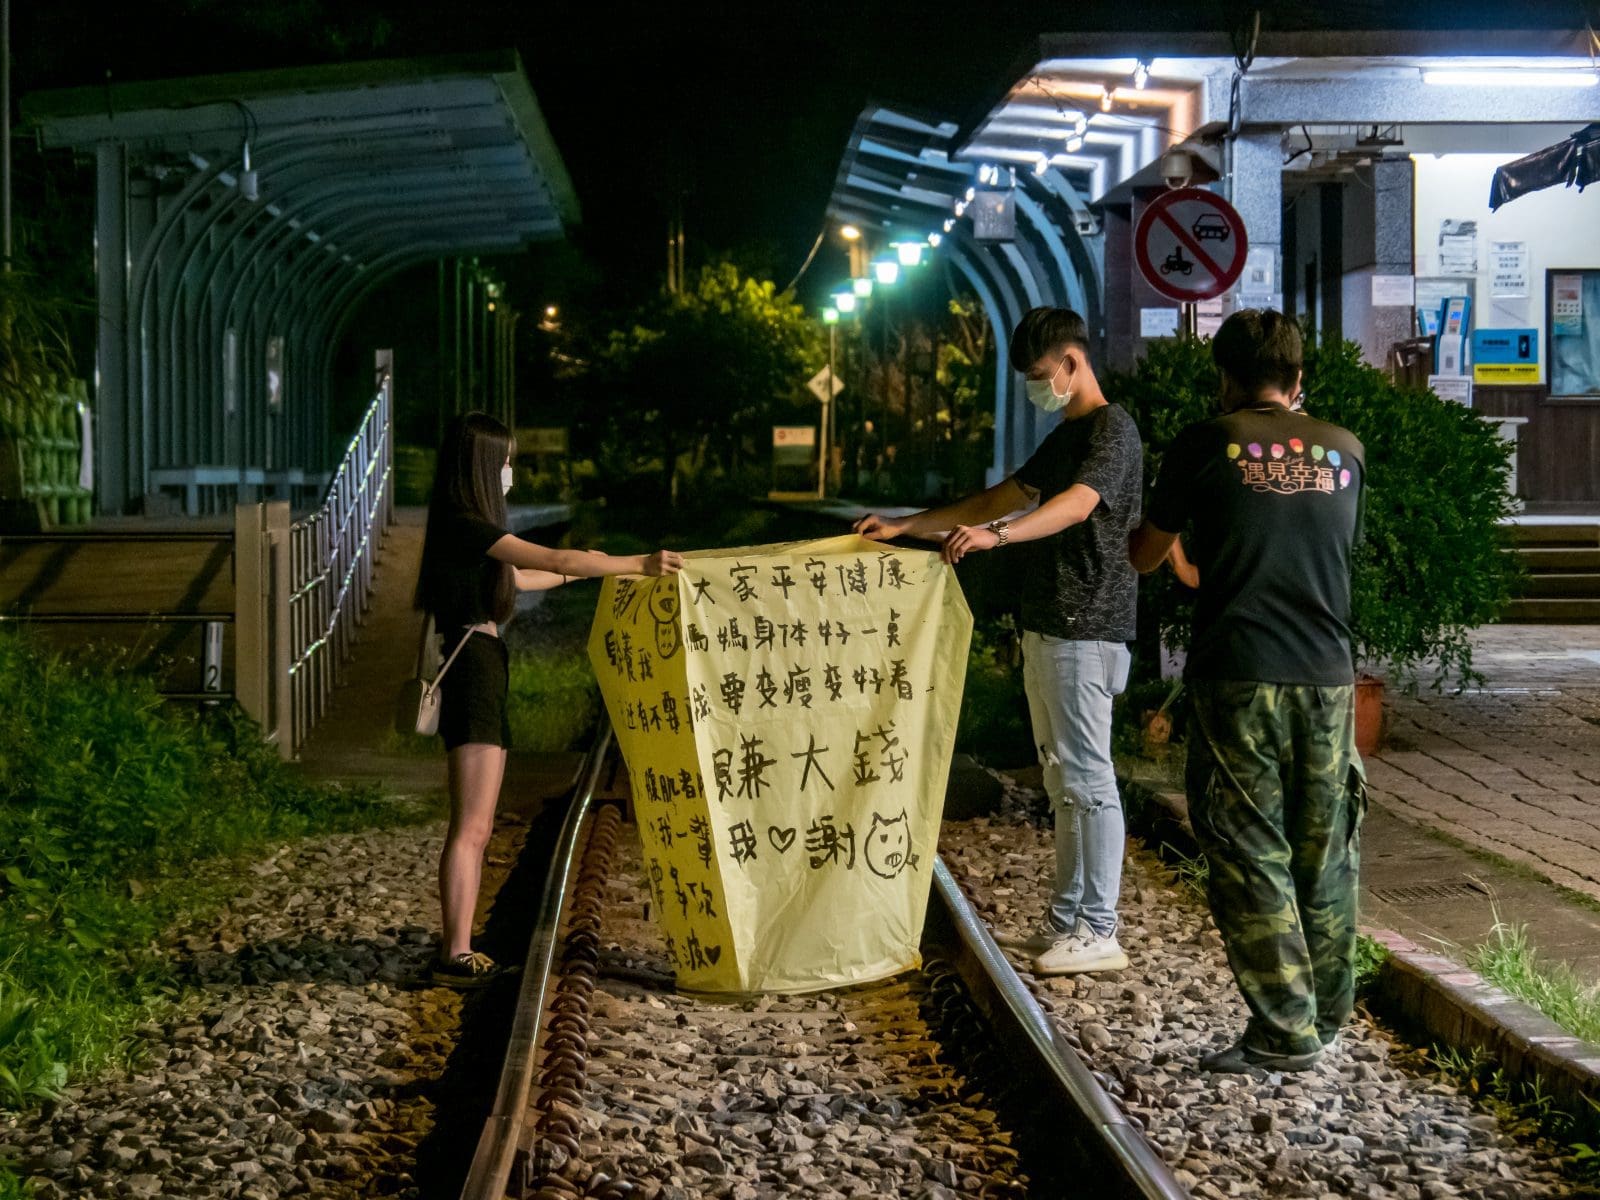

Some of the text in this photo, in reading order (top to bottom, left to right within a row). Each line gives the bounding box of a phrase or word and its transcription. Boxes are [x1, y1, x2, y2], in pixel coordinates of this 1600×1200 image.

[1241, 461, 1335, 492] 遇見幸福
[693, 552, 914, 605] 大家平安健康
[207, 665, 218, 691] 2
[712, 719, 909, 802] 賺大錢
[729, 815, 856, 870] 我 謝
